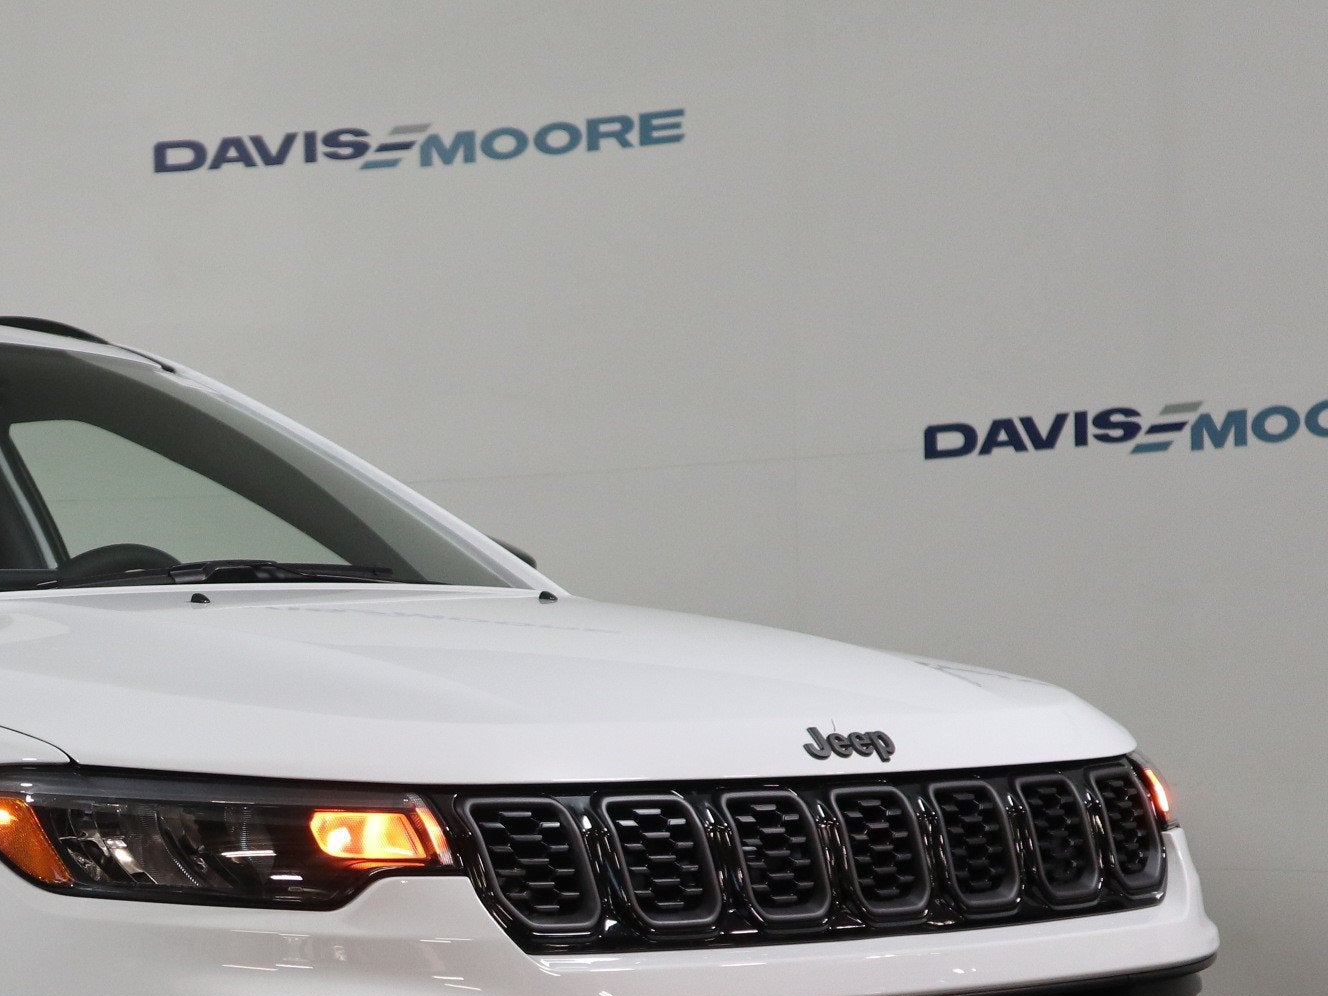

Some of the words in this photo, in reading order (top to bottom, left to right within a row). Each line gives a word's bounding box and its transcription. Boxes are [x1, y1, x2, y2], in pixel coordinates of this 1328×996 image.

[154, 127, 371, 173] DAVIS
[420, 108, 685, 168] MOORE
[924, 407, 1142, 460] DAVIS
[803, 726, 896, 763] Jeep
